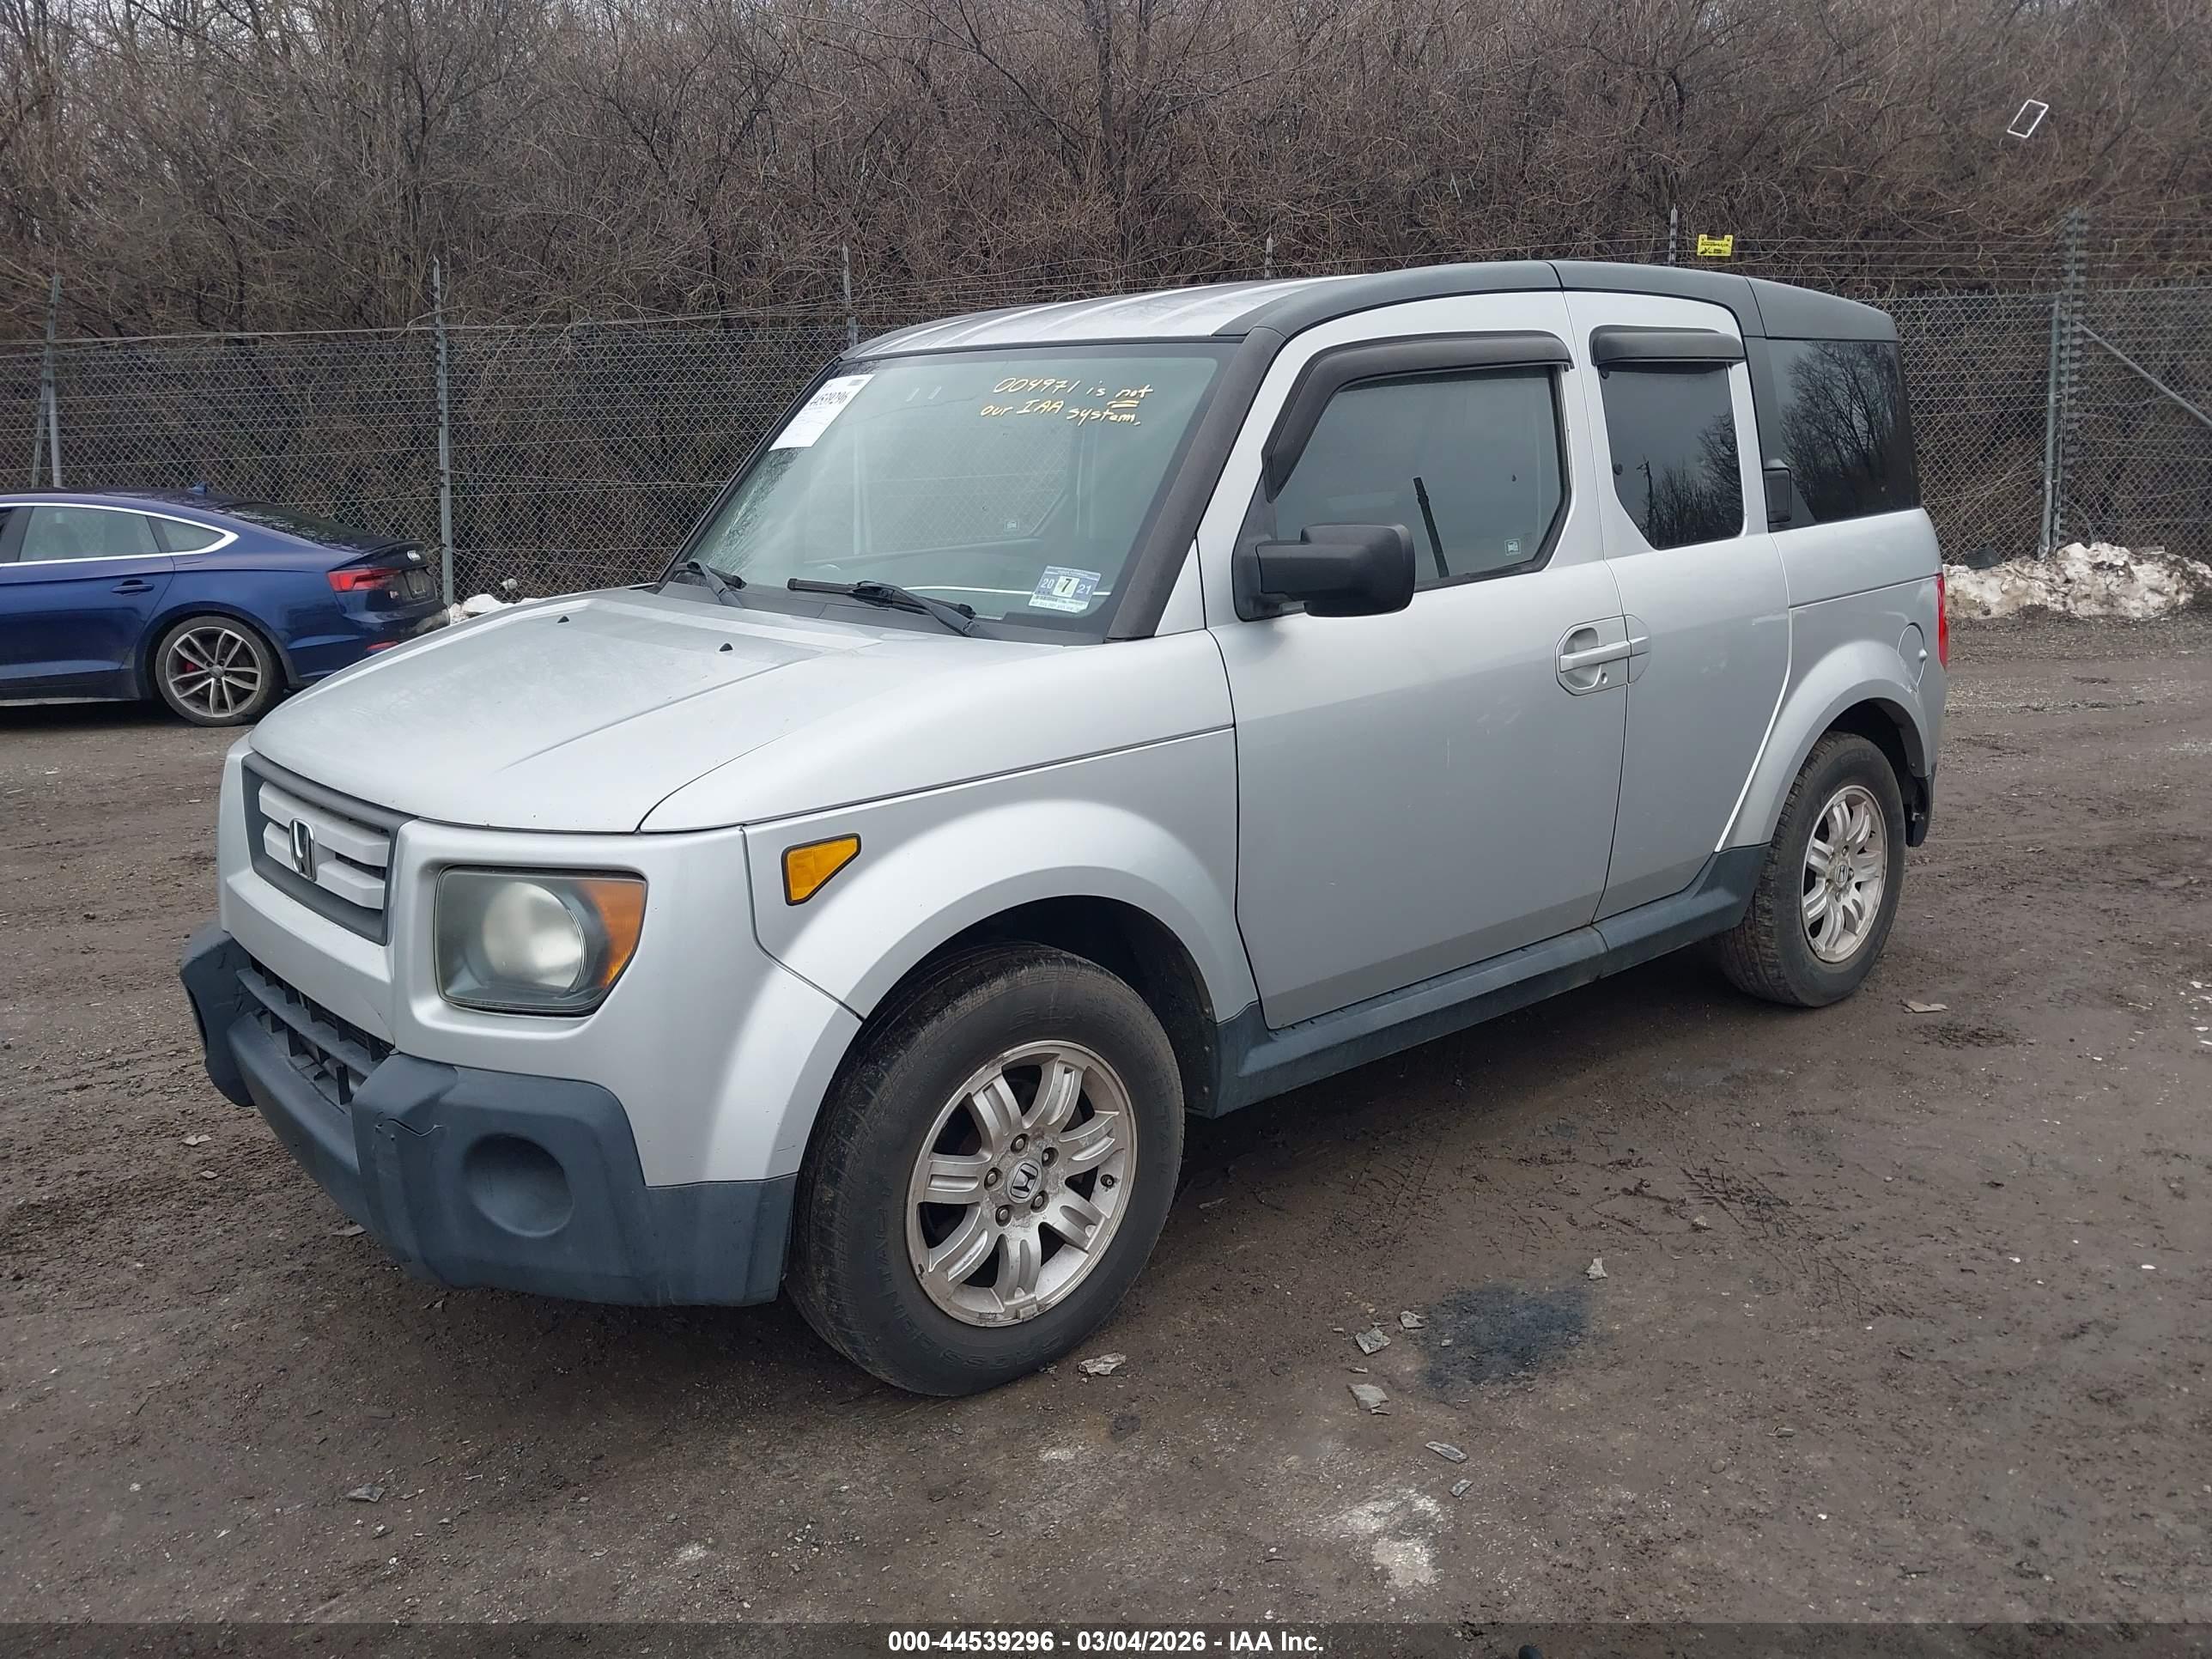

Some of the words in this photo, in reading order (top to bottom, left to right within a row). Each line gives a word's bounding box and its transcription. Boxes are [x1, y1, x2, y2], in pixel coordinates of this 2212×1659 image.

[993, 377, 1081, 395] 004971
[1085, 380, 1106, 397] is
[1115, 384, 1154, 398] not
[980, 404, 1014, 416] our
[1016, 398, 1065, 415] IAA
[1040, 578, 1055, 589] 20
[1060, 578, 1073, 593] 7
[1076, 584, 1092, 595] 21
